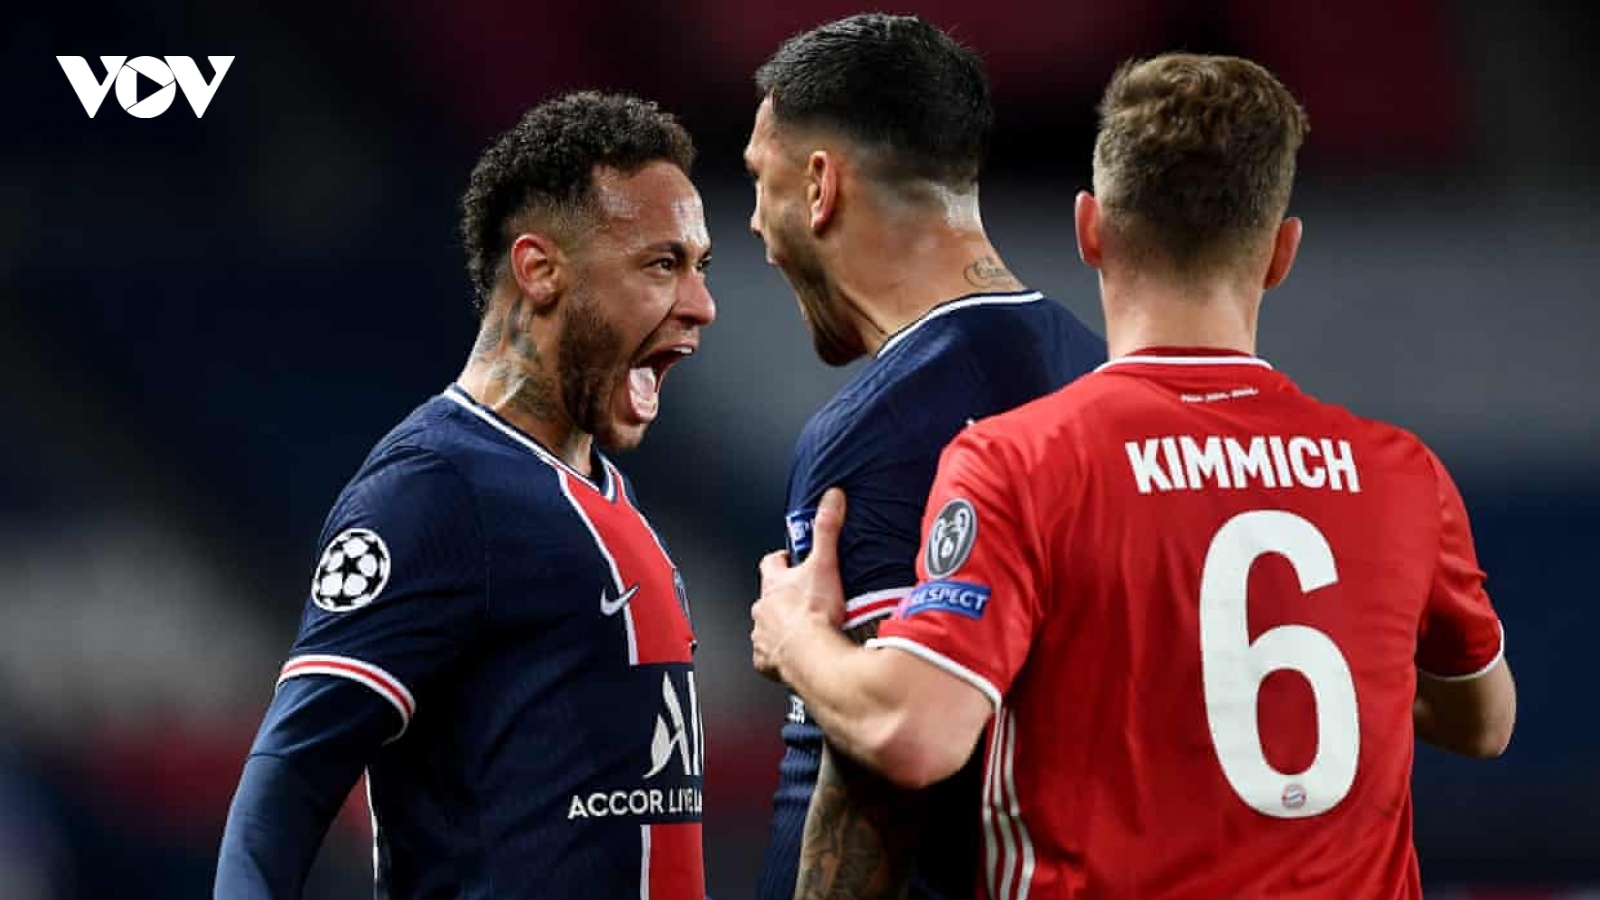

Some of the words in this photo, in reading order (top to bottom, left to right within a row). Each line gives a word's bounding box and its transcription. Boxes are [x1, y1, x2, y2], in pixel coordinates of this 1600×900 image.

[1124, 434, 1362, 495] KIMMICH
[1199, 509, 1361, 819] 6
[567, 788, 665, 820] ACCOR
